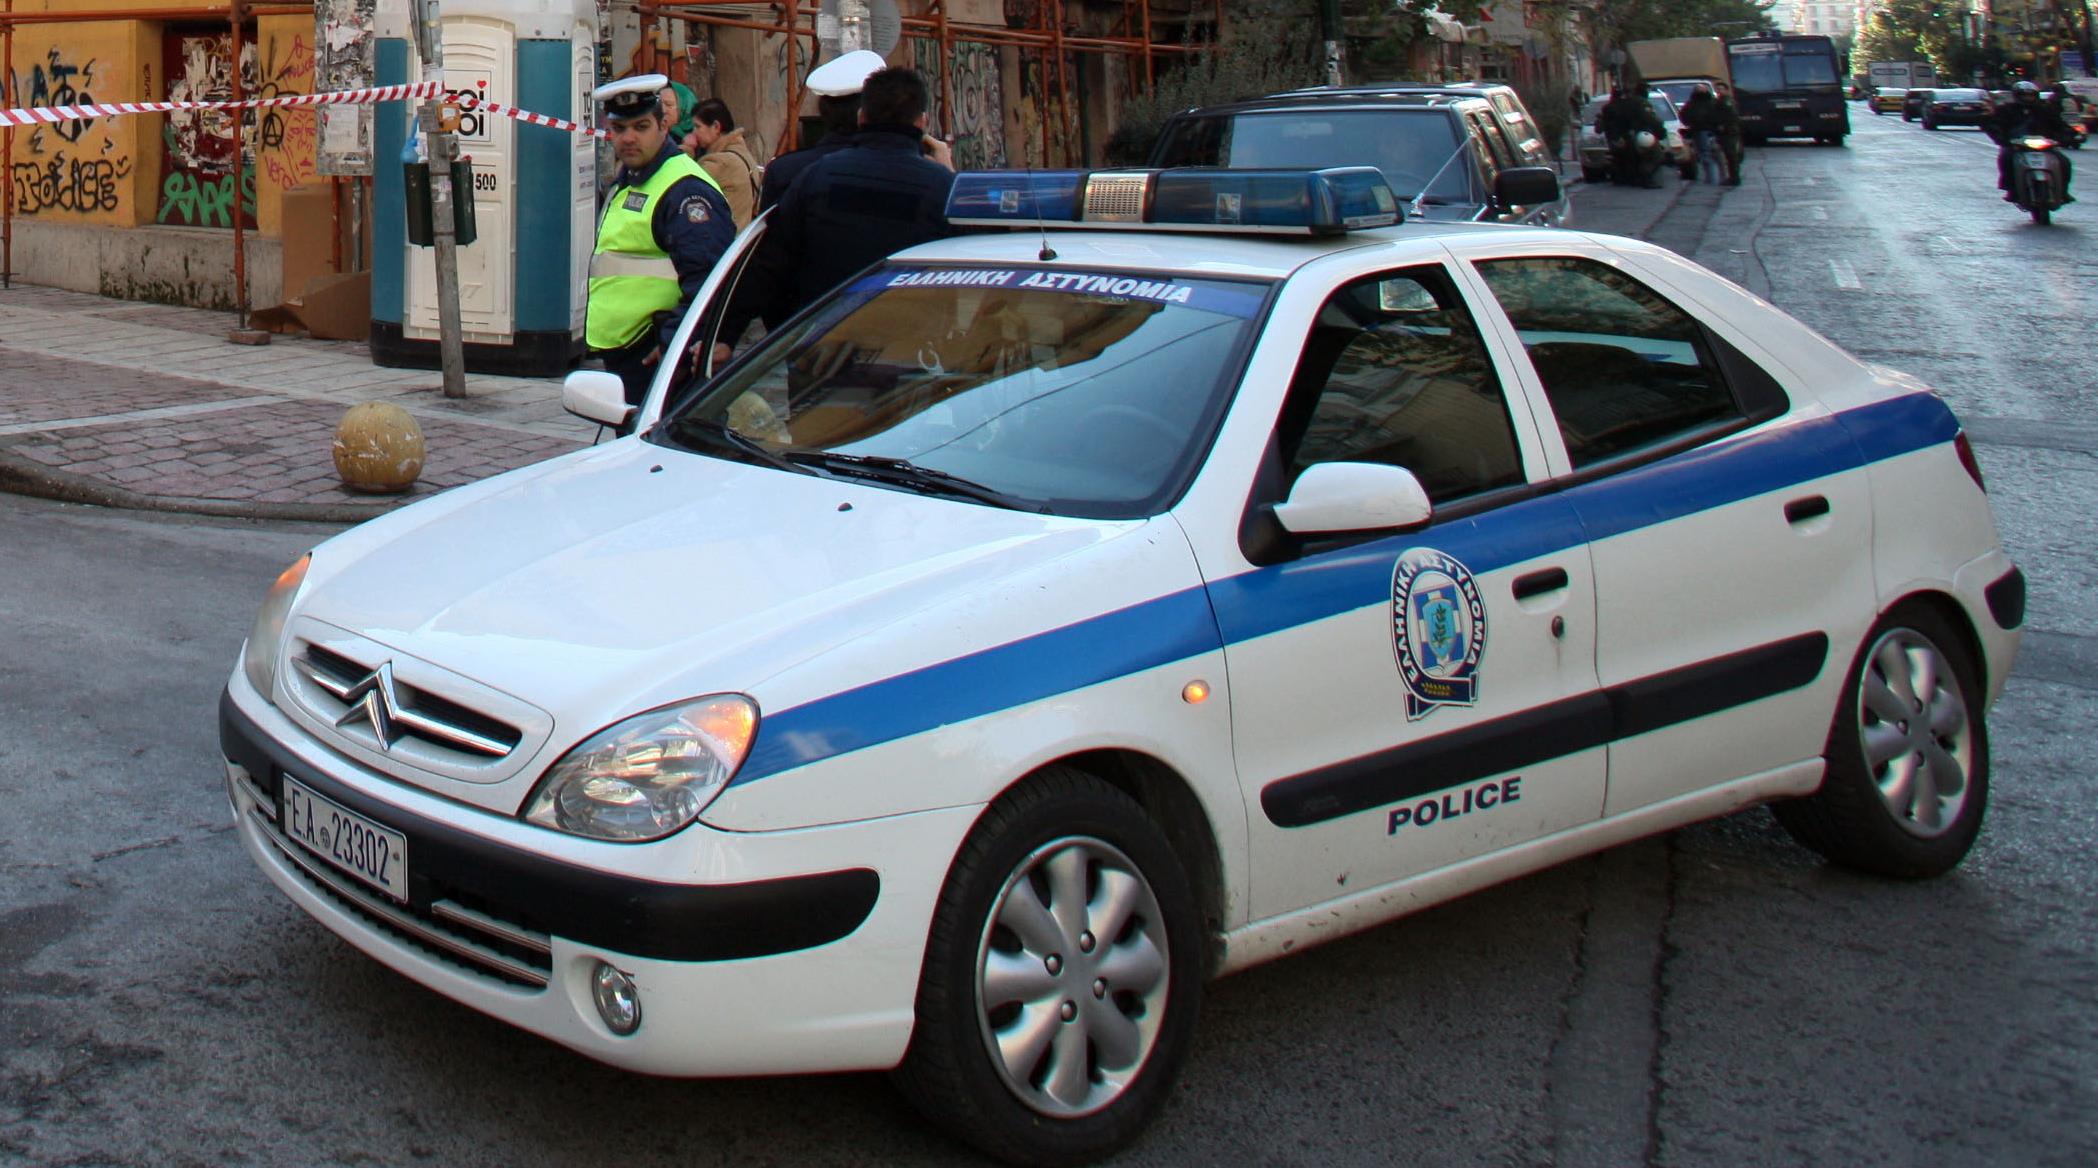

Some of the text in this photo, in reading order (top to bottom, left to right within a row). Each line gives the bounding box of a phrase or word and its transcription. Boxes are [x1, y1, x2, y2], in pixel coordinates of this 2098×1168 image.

[887, 270, 1192, 303] ΕΛΛΗΝΙΚΗ ΑΣΤΥΝΟΜΙΑ
[1393, 553, 1485, 683] ΕΛΛΗΝΙΚΗ ΑΣΤΥΝΟΜΙΑ
[1388, 775, 1522, 836] POLICE
[331, 811, 391, 886] 23302
